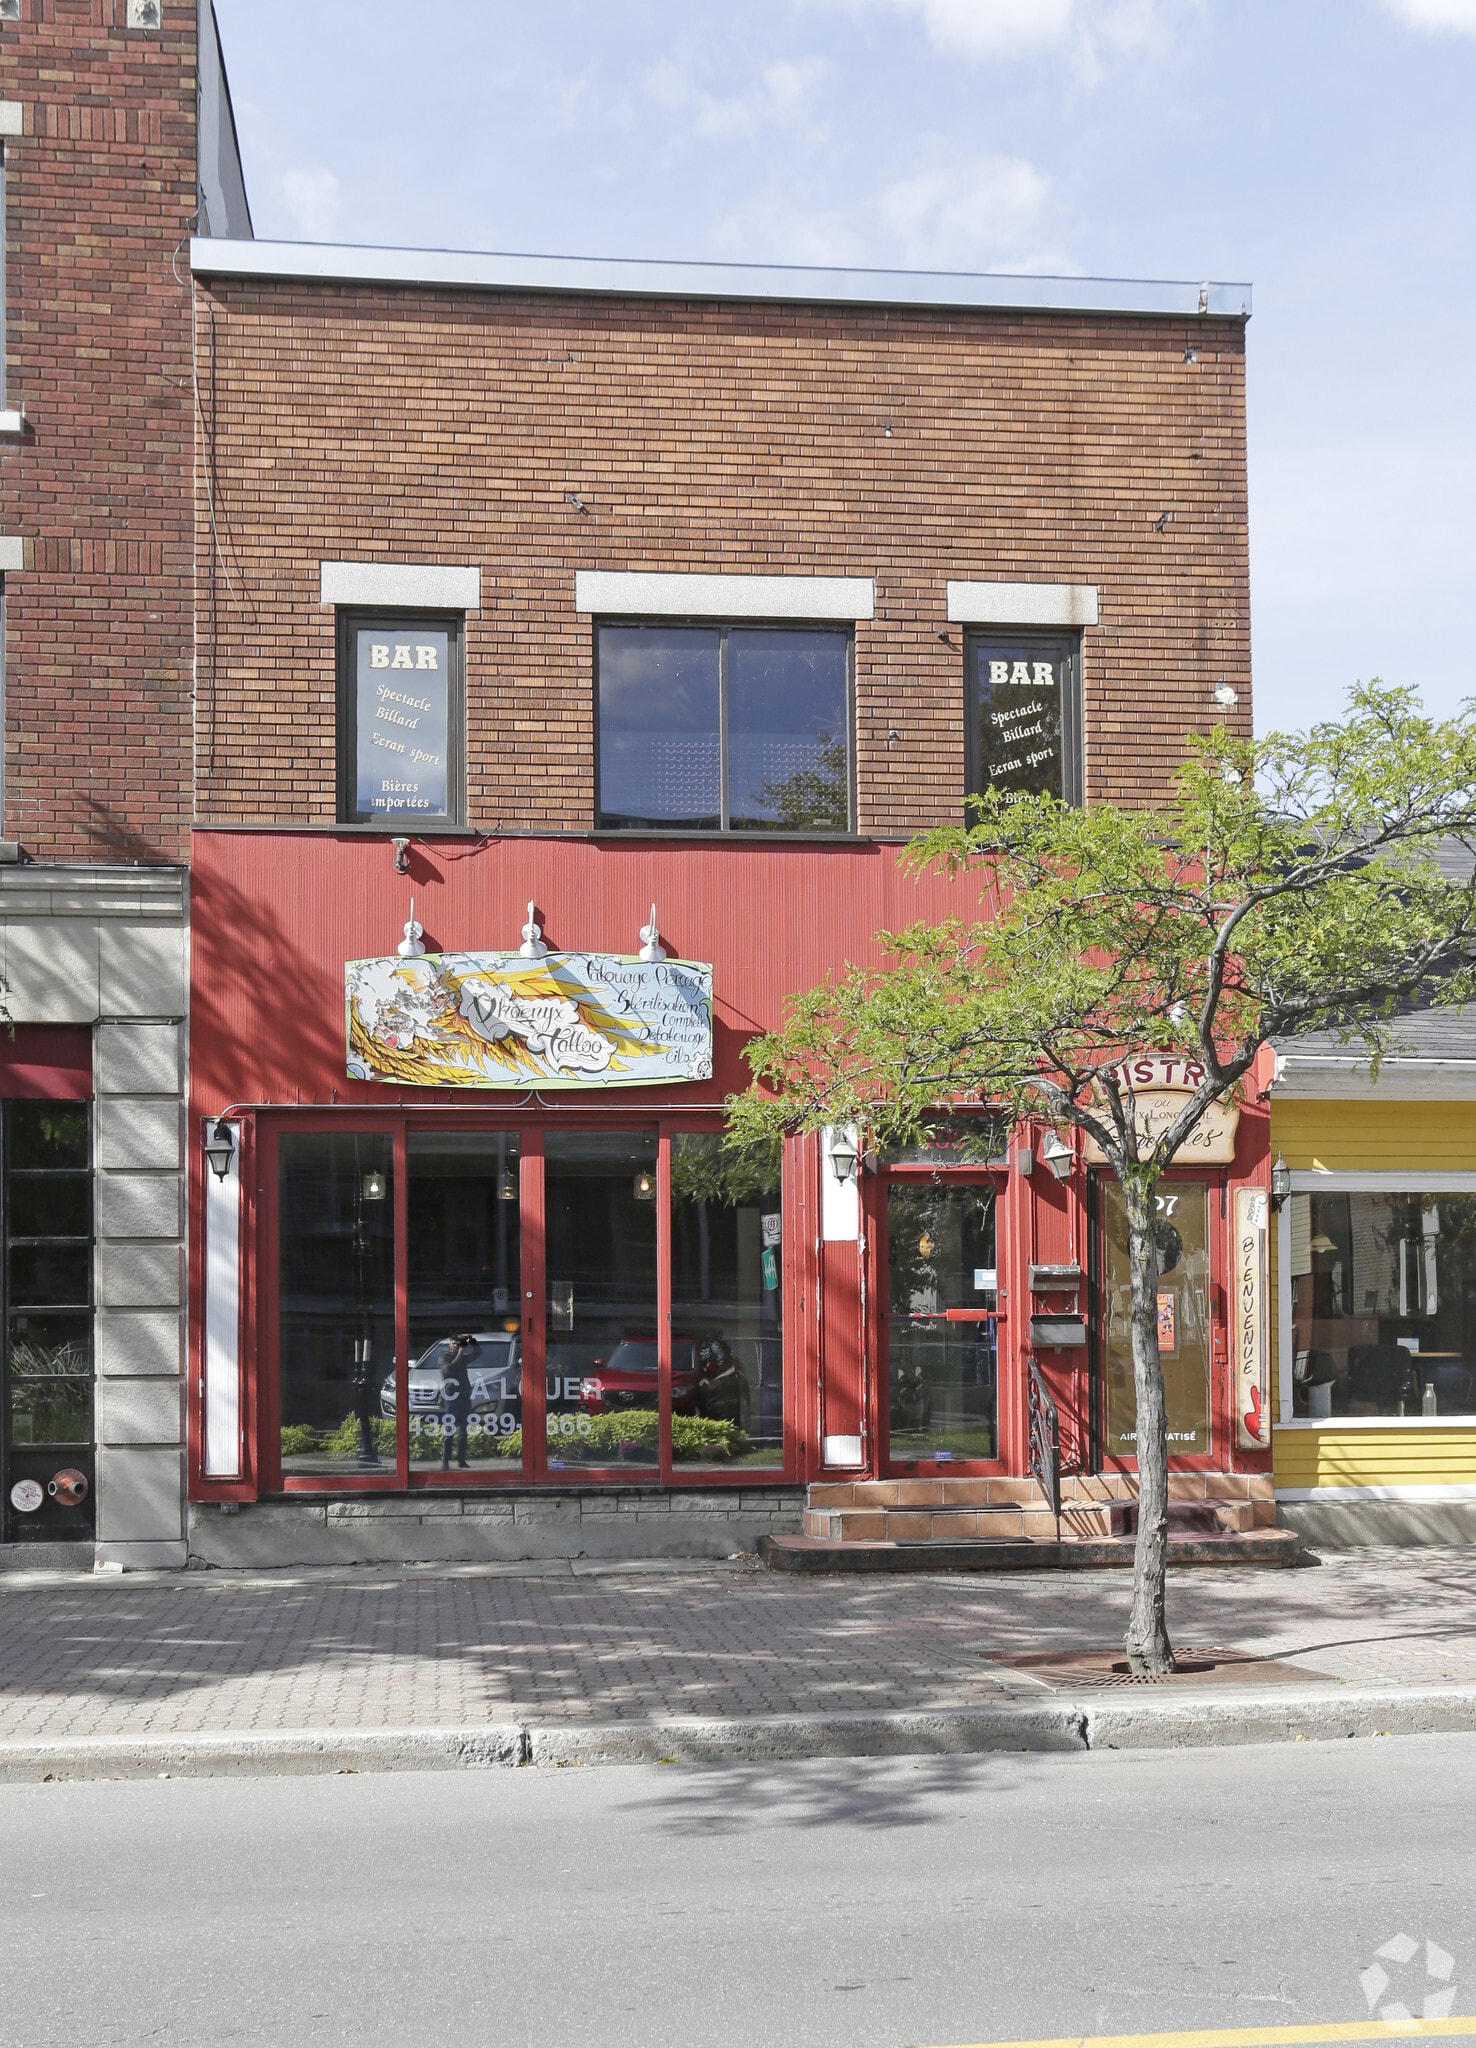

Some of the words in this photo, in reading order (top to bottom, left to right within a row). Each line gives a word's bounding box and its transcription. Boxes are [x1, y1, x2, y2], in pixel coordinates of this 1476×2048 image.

[370, 644, 438, 670] BAR
[988, 660, 1054, 686] BAR
[376, 683, 431, 712] Spectacle
[375, 706, 420, 730] Billard
[991, 700, 1043, 727] Spectacle
[1003, 720, 1043, 743] Billard
[409, 747, 440, 766] sport
[988, 759, 1022, 778] Ecran
[1026, 746, 1054, 768] sport
[381, 779, 419, 793] Bières
[371, 795, 429, 812] importées
[584, 960, 650, 993] Tatouage
[1096, 1059, 1205, 1096] BISTR
[1242, 1236, 1255, 1375] BIENVENUE
[470, 1371, 490, 1399] À
[501, 1377, 602, 1400] LUER
[1120, 1432, 1137, 1441] AIR
